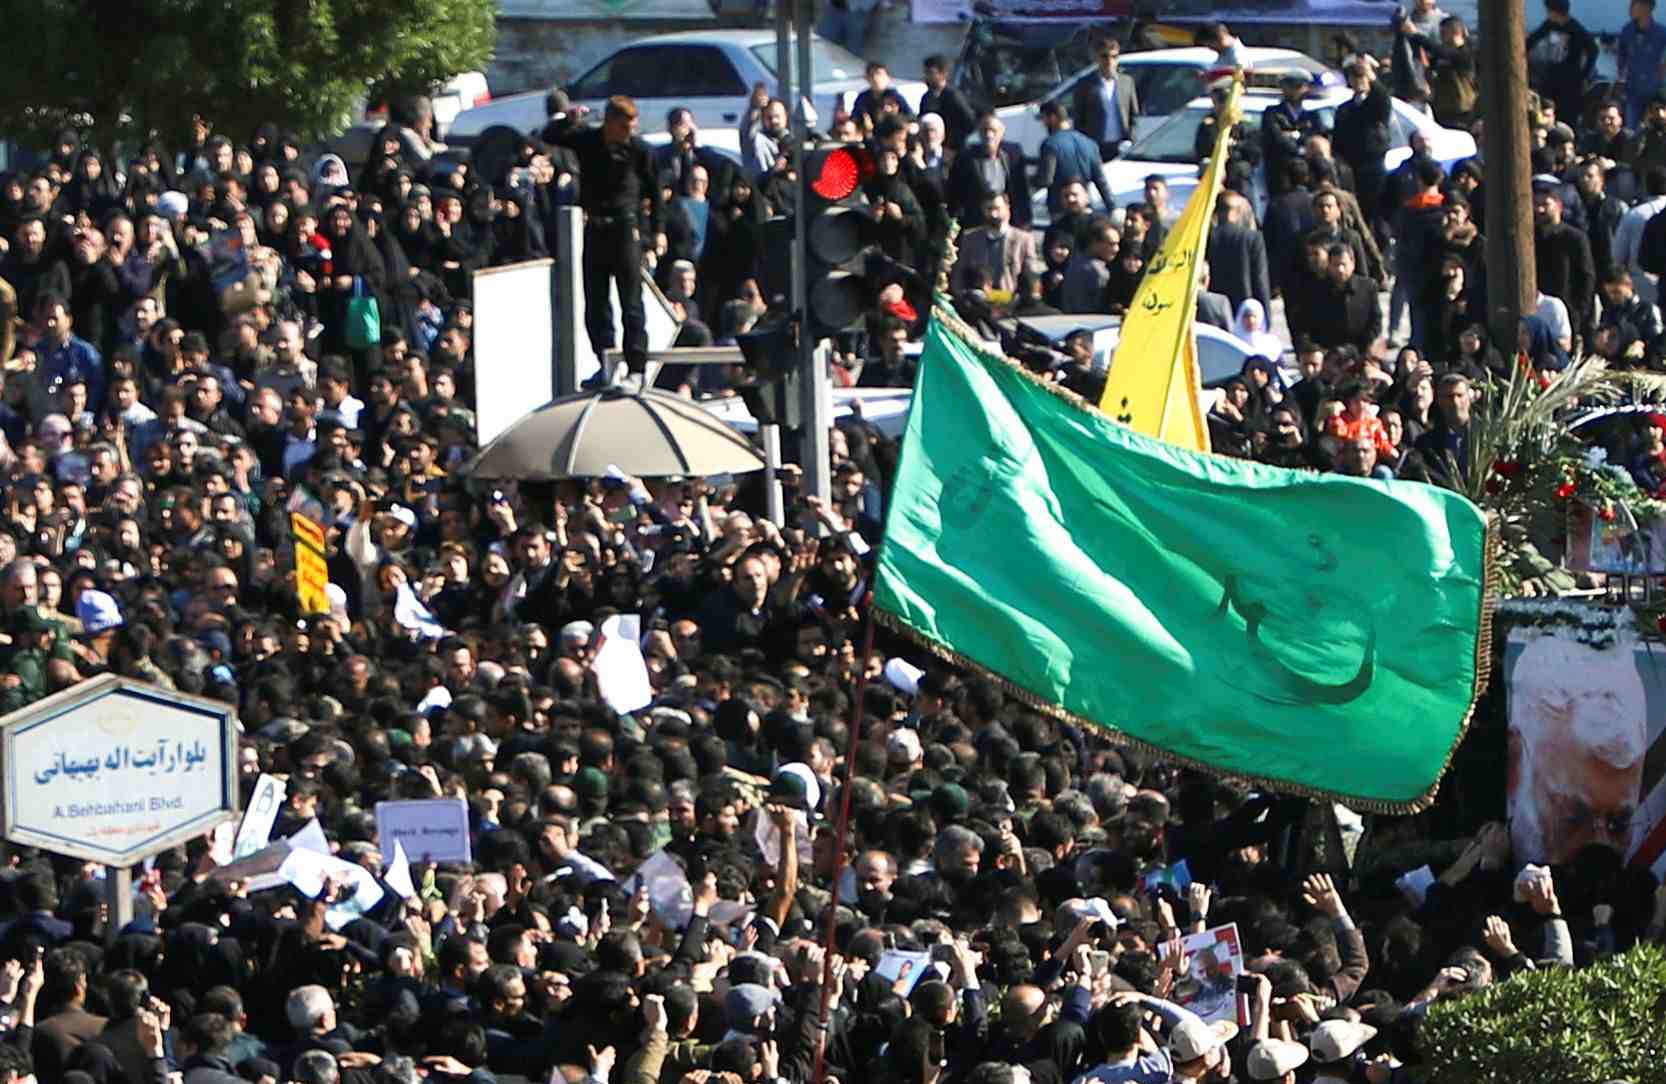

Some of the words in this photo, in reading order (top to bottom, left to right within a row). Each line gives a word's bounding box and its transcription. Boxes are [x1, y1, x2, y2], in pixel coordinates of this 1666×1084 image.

[34, 752, 101, 784] بهبهانی
[132, 738, 169, 775] آیت
[163, 740, 207, 773] بلوار
